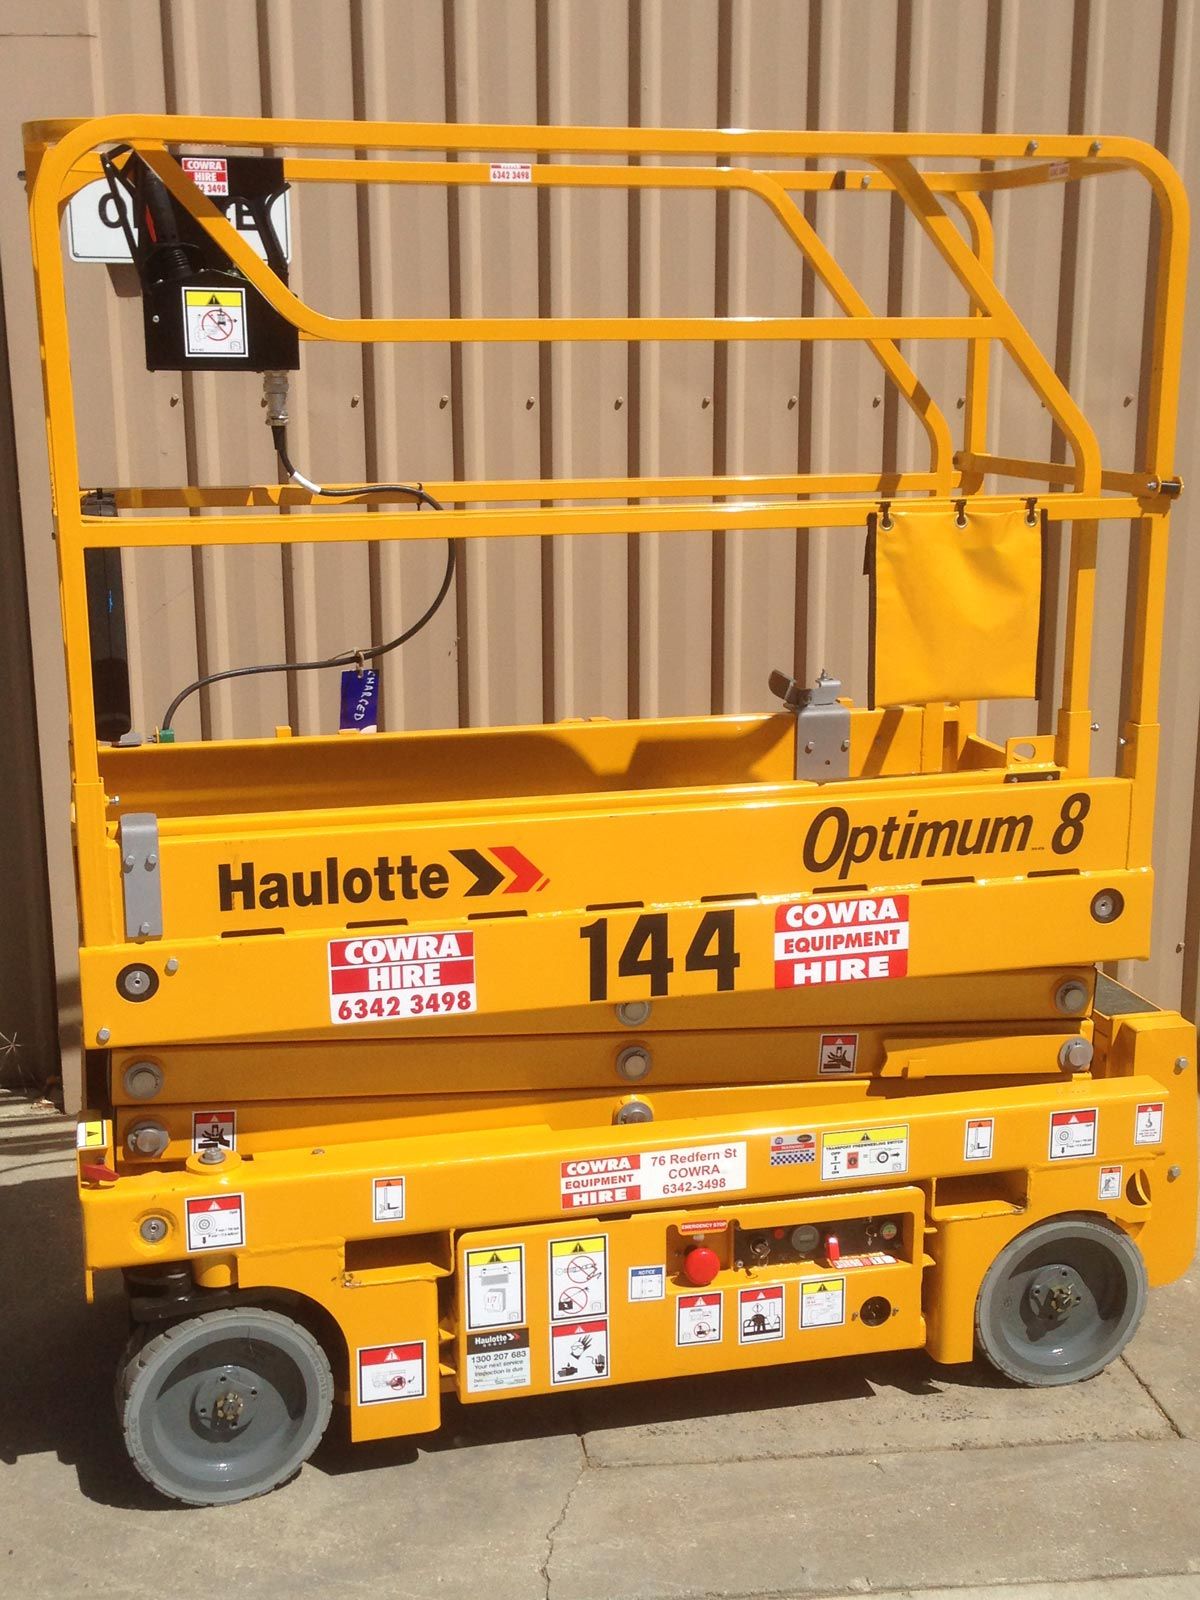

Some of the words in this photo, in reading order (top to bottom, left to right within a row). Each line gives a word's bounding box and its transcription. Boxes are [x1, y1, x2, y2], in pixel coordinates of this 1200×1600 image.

[187, 160, 223, 171] COWRA
[492, 170, 511, 179] 6342
[511, 170, 530, 179] 3498
[194, 172, 218, 182] HIRE
[207, 184, 227, 193] 3498
[802, 806, 1033, 880] Optimum
[1050, 792, 1090, 855] 8
[218, 855, 450, 912] Haulotte
[785, 898, 899, 928] COWRA
[344, 934, 462, 966] COWRA
[783, 929, 901, 955] EQUIPMENT
[580, 909, 741, 1002] 144
[368, 962, 442, 991] HIRE
[793, 955, 890, 986] HIRE
[338, 996, 401, 1021] 6342
[409, 990, 472, 1014] 3498
[567, 1156, 632, 1176] COWRA
[651, 1155, 666, 1168] 76
[670, 1150, 720, 1165] Redfern
[724, 1148, 738, 1159] St
[565, 1173, 634, 1190] EQUIPMENT
[668, 1164, 721, 1180] COWRA
[662, 1178, 727, 1195] 6342-3498
[572, 1187, 628, 1207] HIRE
[474, 1334, 507, 1346] Haulotte
[471, 1354, 492, 1364] 1300
[493, 1352, 509, 1361] 207
[511, 1350, 527, 1359] 683
